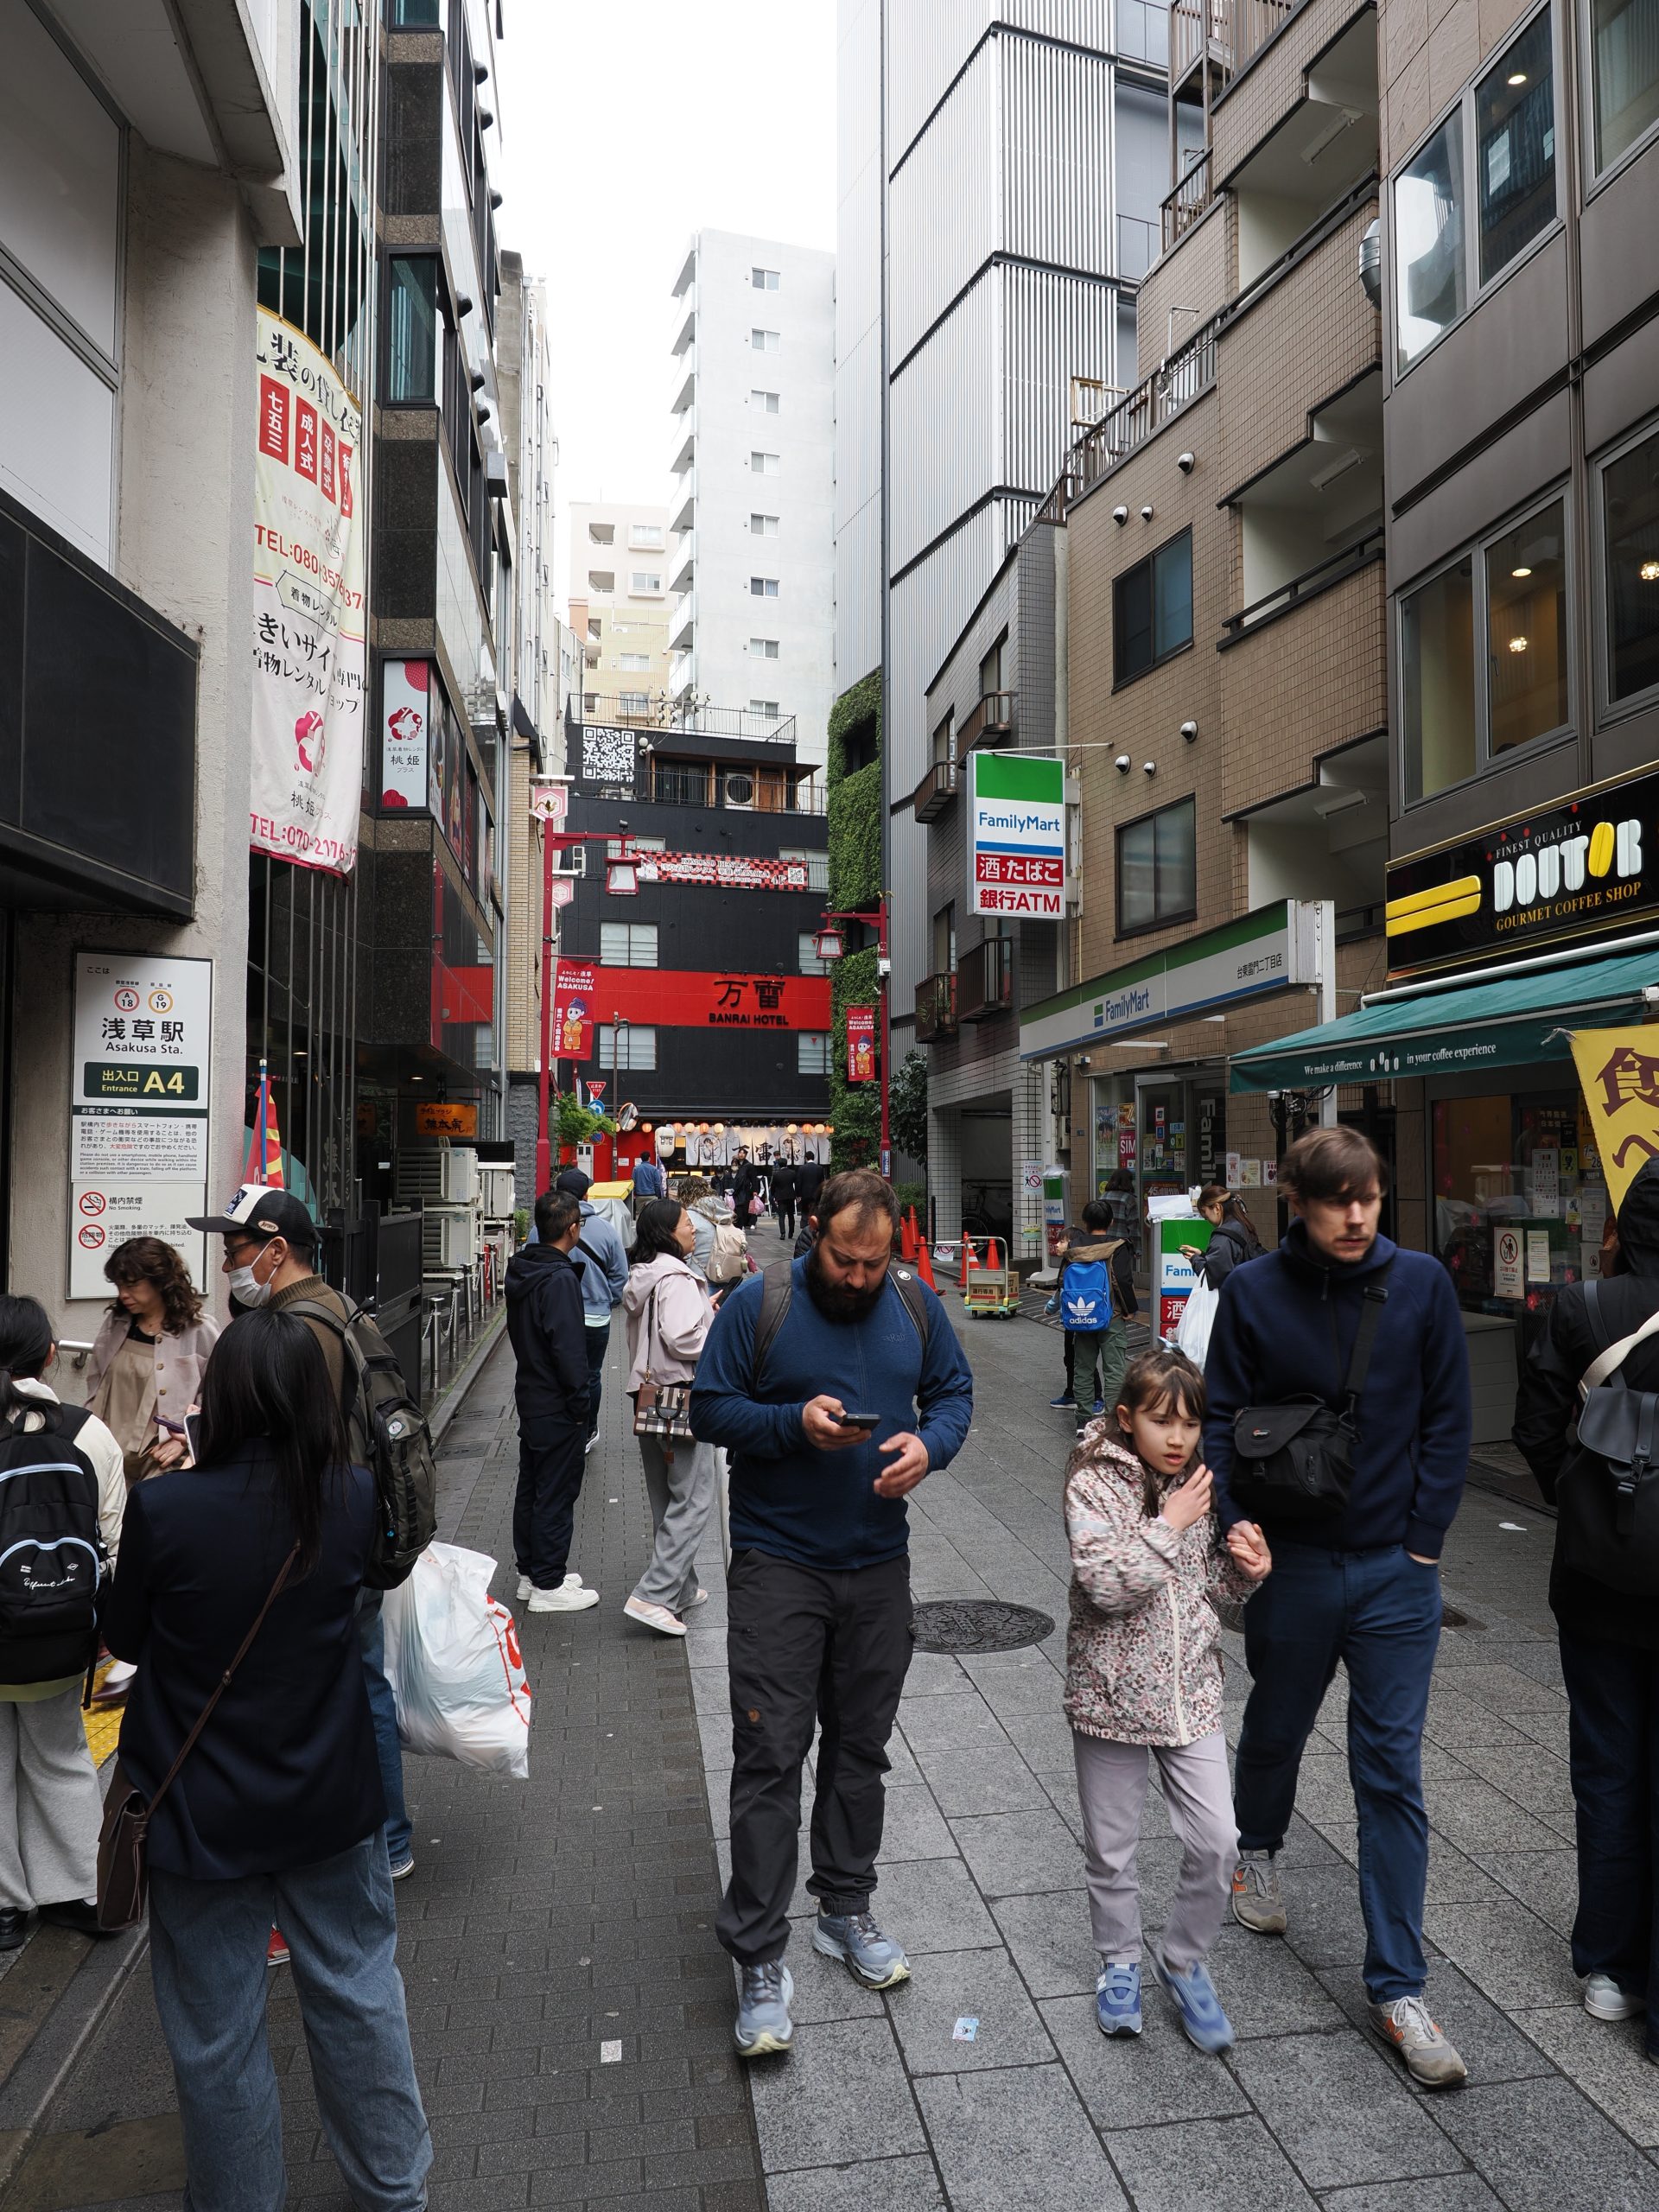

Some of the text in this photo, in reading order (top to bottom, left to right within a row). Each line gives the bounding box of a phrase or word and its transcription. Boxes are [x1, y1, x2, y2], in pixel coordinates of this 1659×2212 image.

[266, 391, 283, 454] 七五三
[301, 414, 314, 474] 成人式
[290, 587, 337, 626] 着物レンタル
[391, 754, 420, 766] 桃姫
[291, 791, 315, 817] 桃姫
[979, 812, 1059, 833] FamilyMart
[1496, 821, 1582, 859] FINEST QUALITY
[1494, 819, 1642, 912] DOUTOR
[980, 889, 1059, 912] 銀行ATM
[1496, 881, 1641, 931] GOURMET COFFEE SHOP
[86, 966, 110, 975] ここは
[1237, 953, 1282, 979] 台東雷門二丁目店
[557, 982, 594, 991] ASAKUSA
[558, 976, 594, 984] Welcome!
[714, 981, 785, 1008] 万雷
[1106, 988, 1149, 1021] FamilyMart
[101, 1017, 184, 1043] 浅草駅
[709, 1013, 789, 1025] BANRAI HOTEL
[105, 1042, 183, 1054] Asakusa Sta.
[1305, 1065, 1313, 1075] We
[1313, 1064, 1329, 1074] make
[1334, 1060, 1363, 1072] difference
[1407, 1053, 1414, 1065] in
[1414, 1054, 1431, 1065] your
[1433, 1048, 1452, 1061] coffee
[1454, 1044, 1496, 1060] experience
[101, 1084, 138, 1093] Entrance
[102, 1071, 138, 1083] 出入口
[143, 1071, 185, 1094] A4
[109, 1197, 143, 1205] 構内禁煙
[1069, 1316, 1097, 1325] adidas
